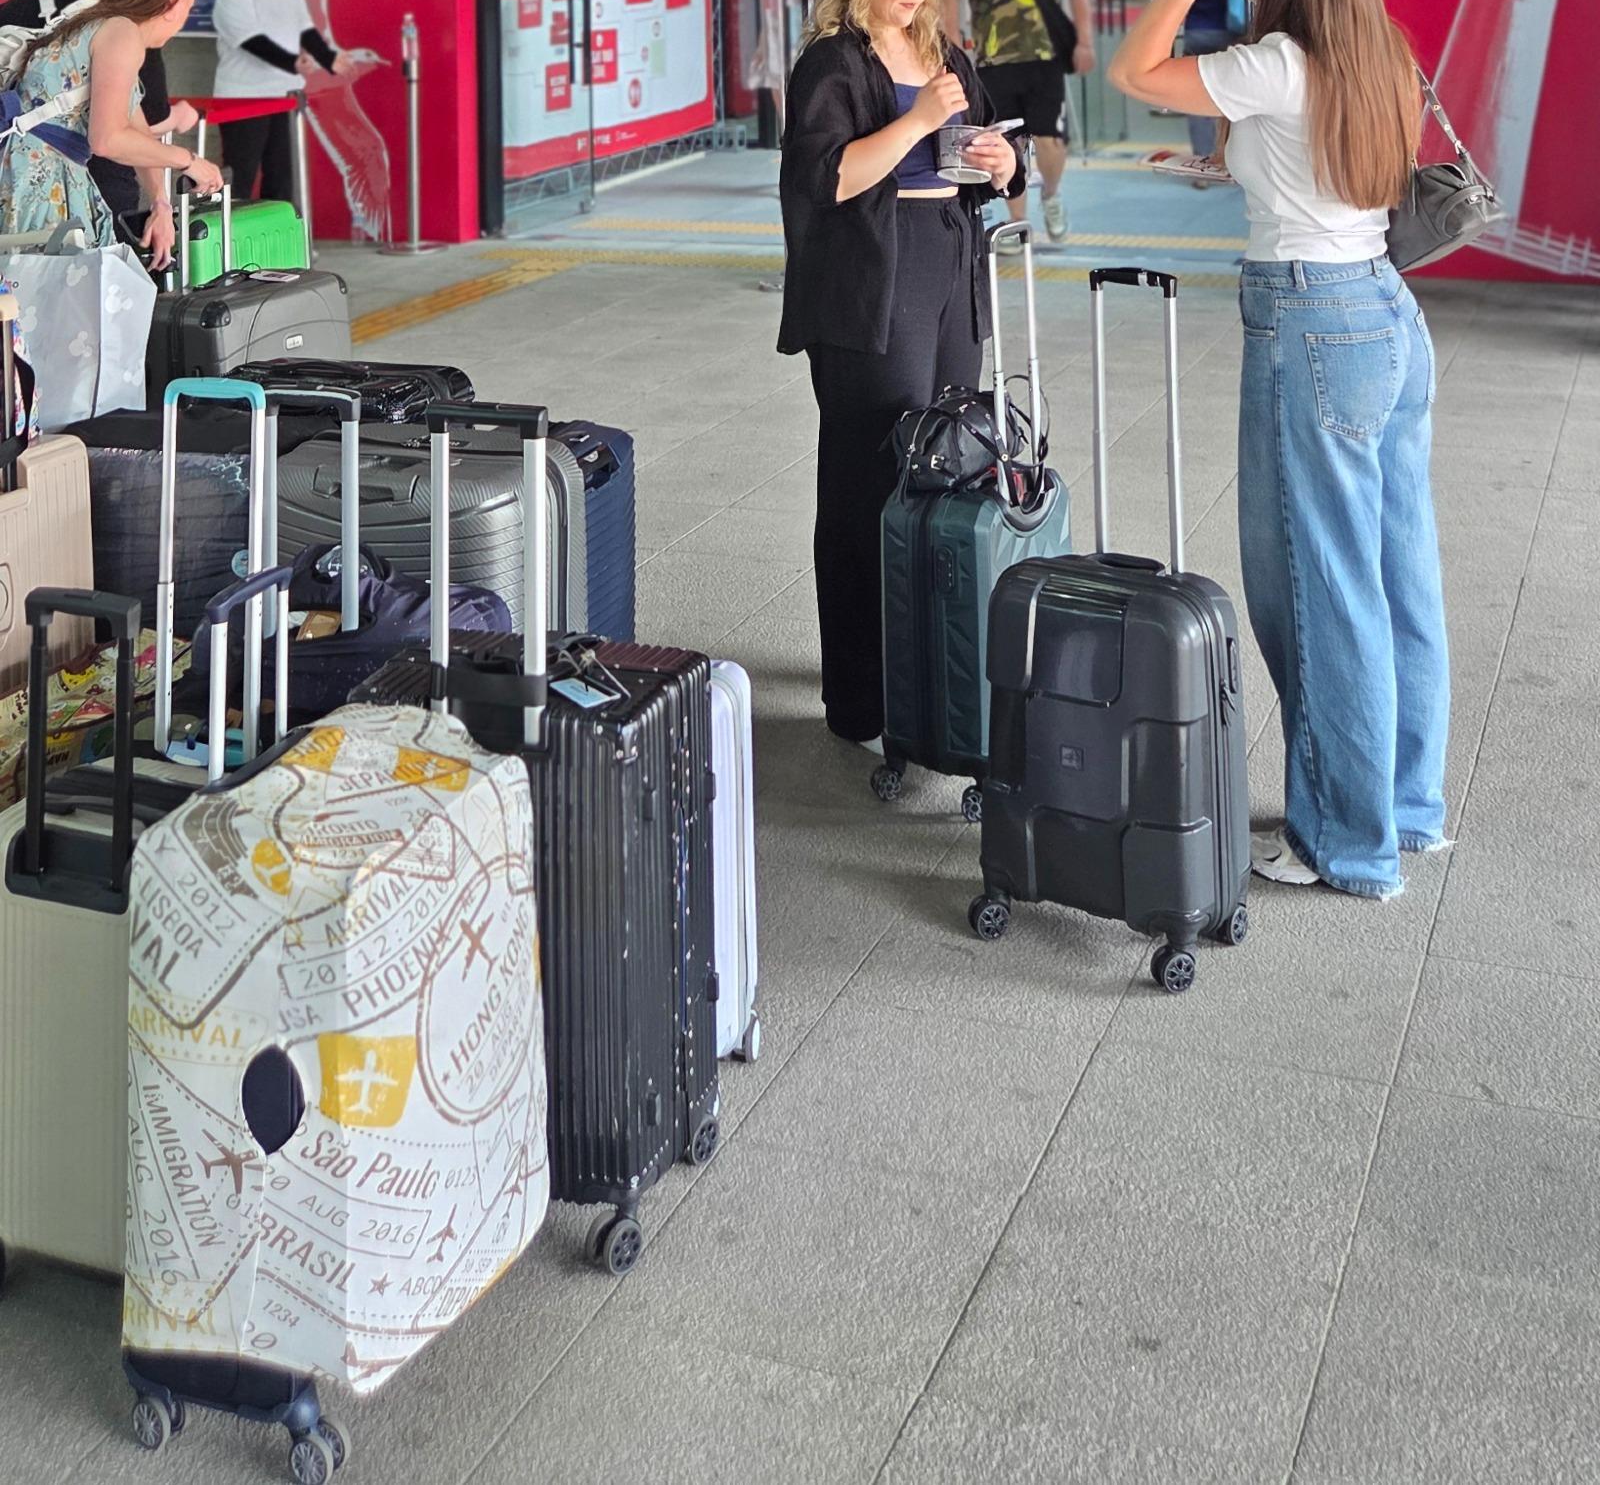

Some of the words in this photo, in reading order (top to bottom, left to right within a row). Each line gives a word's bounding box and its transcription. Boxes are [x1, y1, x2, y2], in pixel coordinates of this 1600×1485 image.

[139, 876, 204, 960] LISBOA
[177, 872, 235, 938] 2012
[324, 876, 414, 949] ARRIVAL
[341, 917, 452, 1018] PHOENIX
[450, 982, 503, 1074] HONG
[499, 901, 531, 985] KONG
[129, 1003, 247, 1050] ARRIVAL
[142, 1083, 226, 1248] IMMIGRATION
[300, 1130, 358, 1180] São
[355, 1151, 440, 1200] Paulo
[143, 1209, 190, 1287] 2016
[257, 1213, 356, 1294] BRASIL
[298, 1194, 350, 1229] AUG
[358, 1218, 418, 1245] 2016
[262, 1298, 301, 1328] 1234
